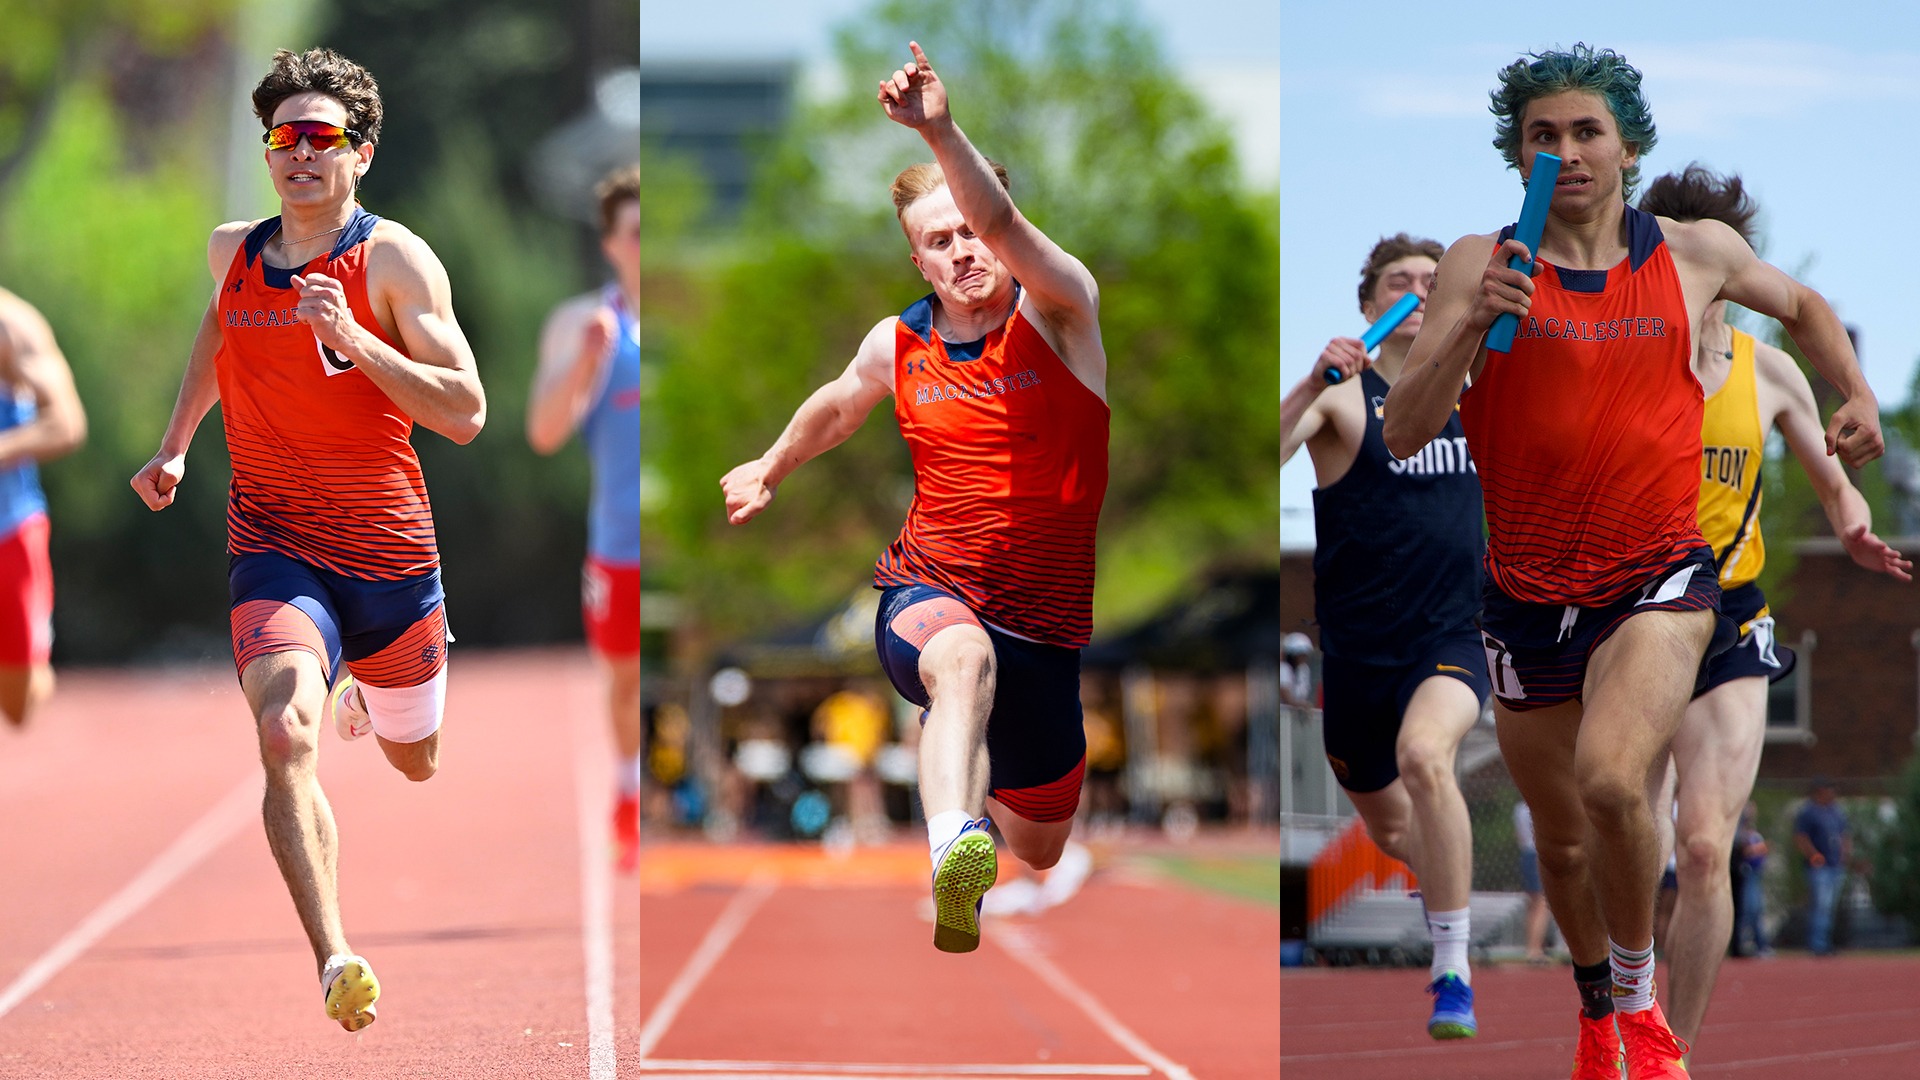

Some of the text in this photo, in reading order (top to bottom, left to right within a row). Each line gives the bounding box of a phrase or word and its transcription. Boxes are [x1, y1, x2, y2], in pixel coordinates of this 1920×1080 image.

[916, 369, 1041, 406] MACALESTER
[1703, 446, 1750, 492] TON
[1484, 636, 1507, 694] 7
